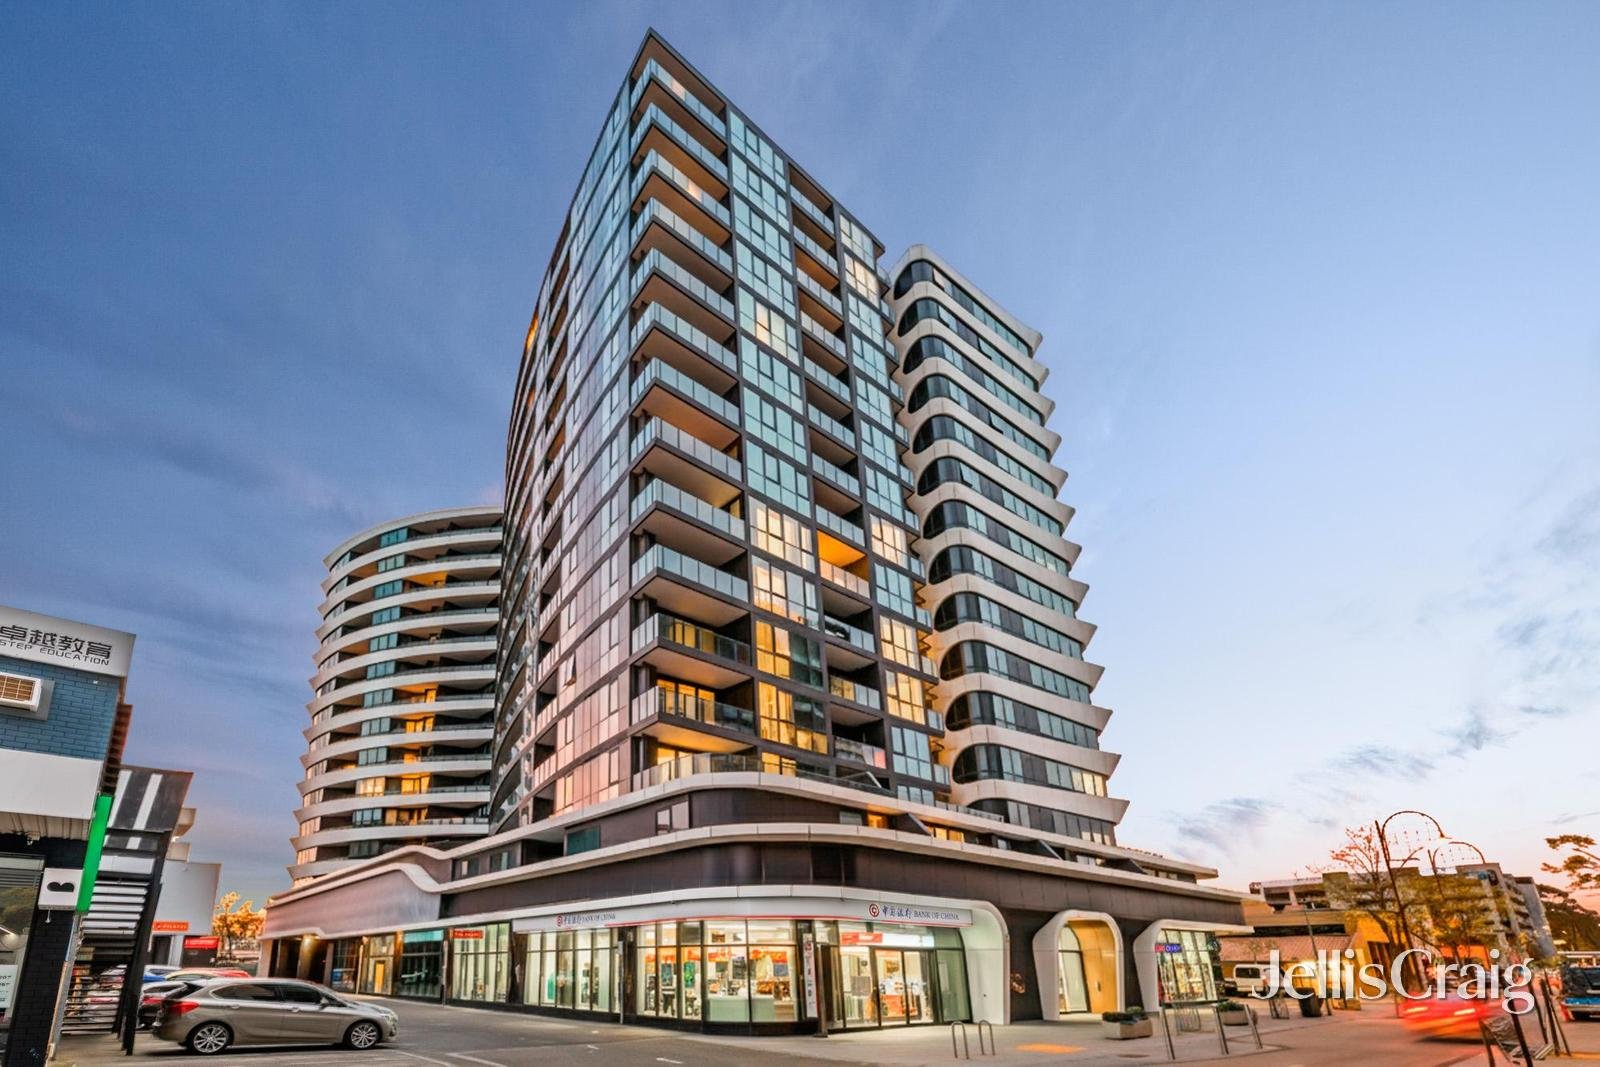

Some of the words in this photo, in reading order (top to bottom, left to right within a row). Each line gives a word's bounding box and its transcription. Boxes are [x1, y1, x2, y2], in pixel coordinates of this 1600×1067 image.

[0, 625, 112, 660] 卓越教育
[39, 647, 110, 666] EDUCATION
[914, 910, 931, 919] BANK
[931, 911, 940, 919] OF
[940, 912, 960, 921] CHINA
